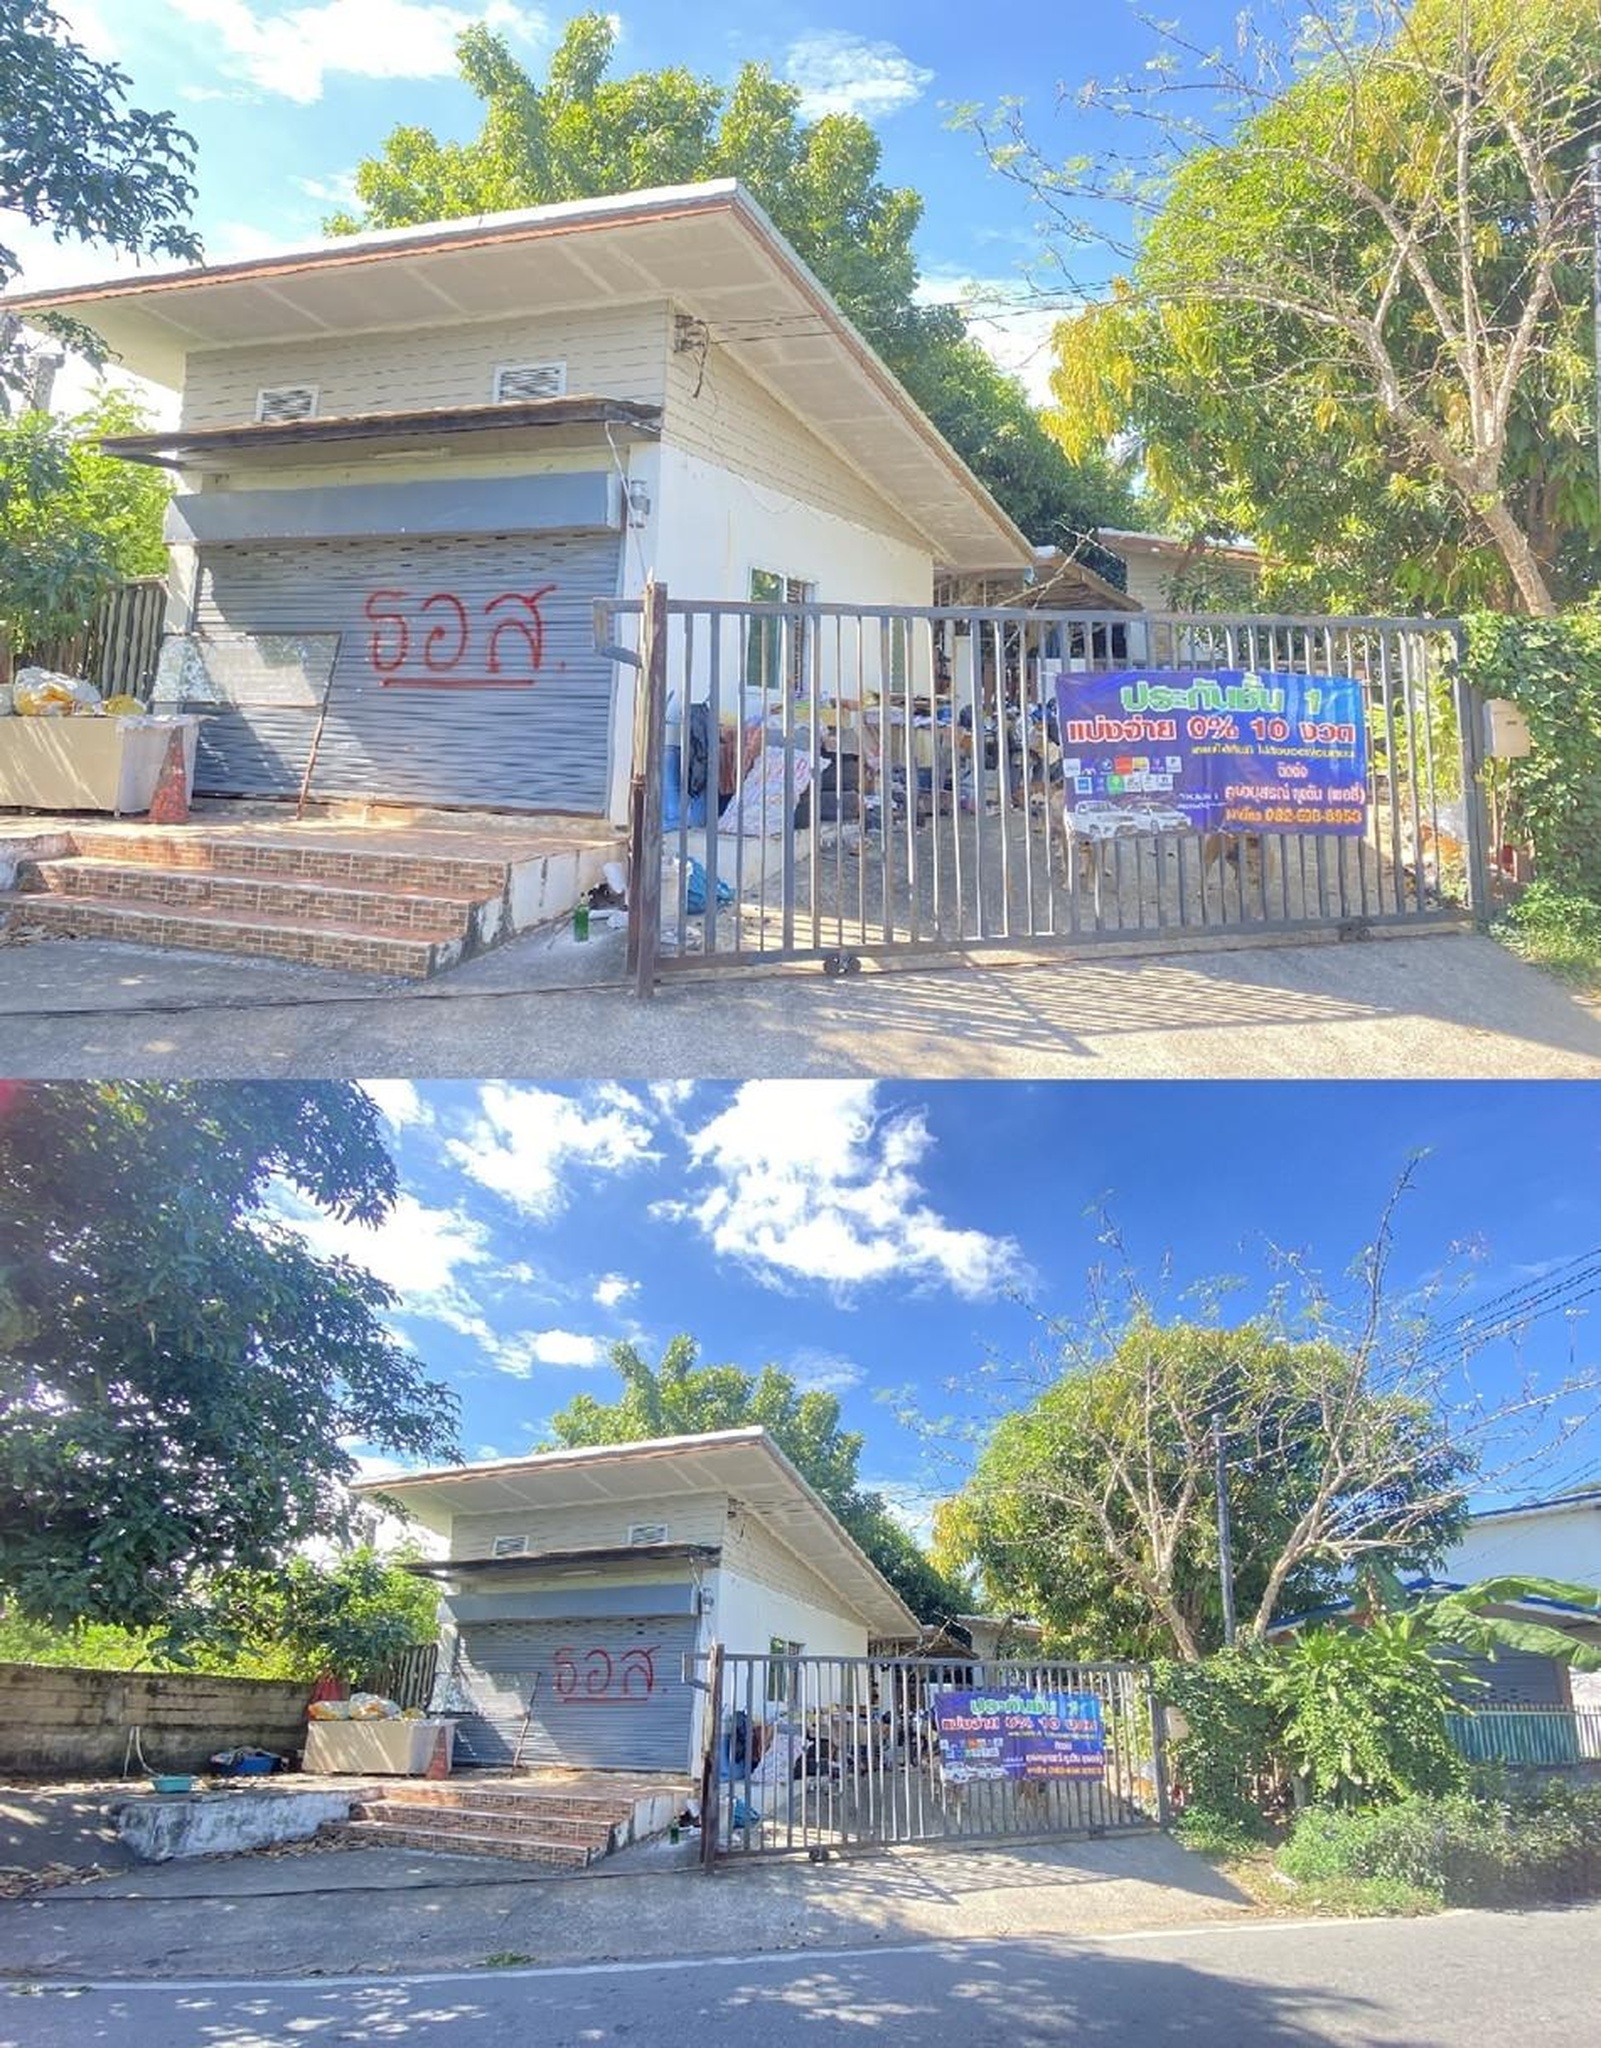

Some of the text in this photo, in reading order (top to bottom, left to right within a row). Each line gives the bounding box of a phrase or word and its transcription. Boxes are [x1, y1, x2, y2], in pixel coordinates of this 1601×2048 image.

[1120, 672, 1322, 715] ประกันชั้น 1
[1067, 715, 1356, 743] แบ่งจ่าย 0% 10 งวด
